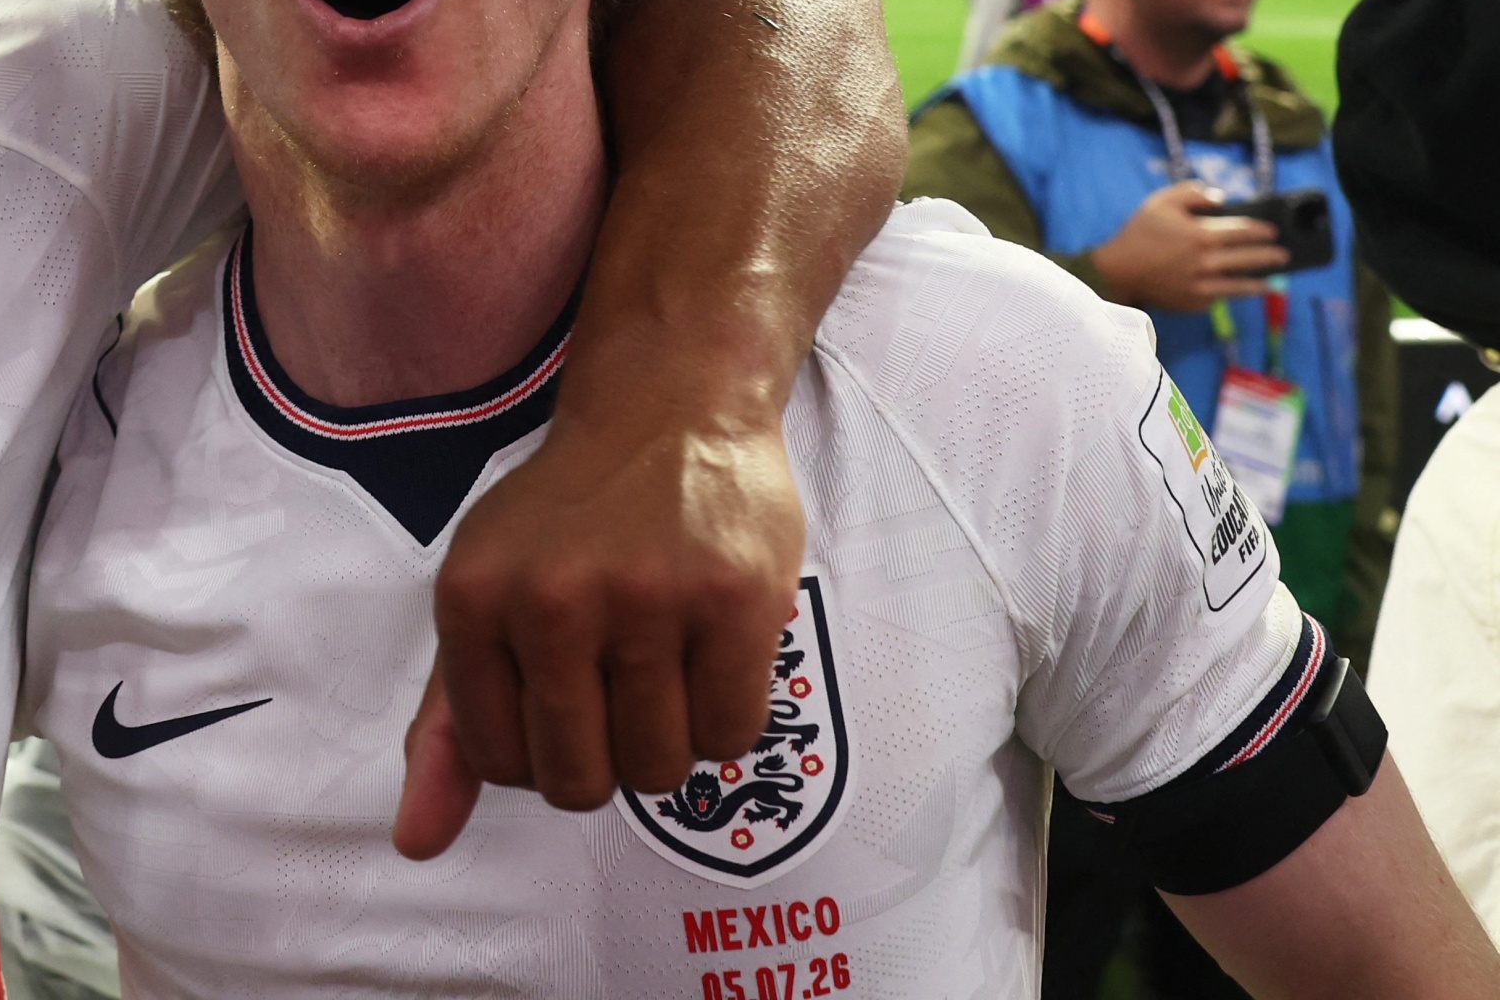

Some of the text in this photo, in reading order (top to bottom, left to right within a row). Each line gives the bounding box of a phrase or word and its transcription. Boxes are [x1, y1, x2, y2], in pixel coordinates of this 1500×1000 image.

[1238, 525, 1261, 564] FIFA
[682, 896, 841, 954] MEXICO
[701, 953, 851, 1000] 0507.26
